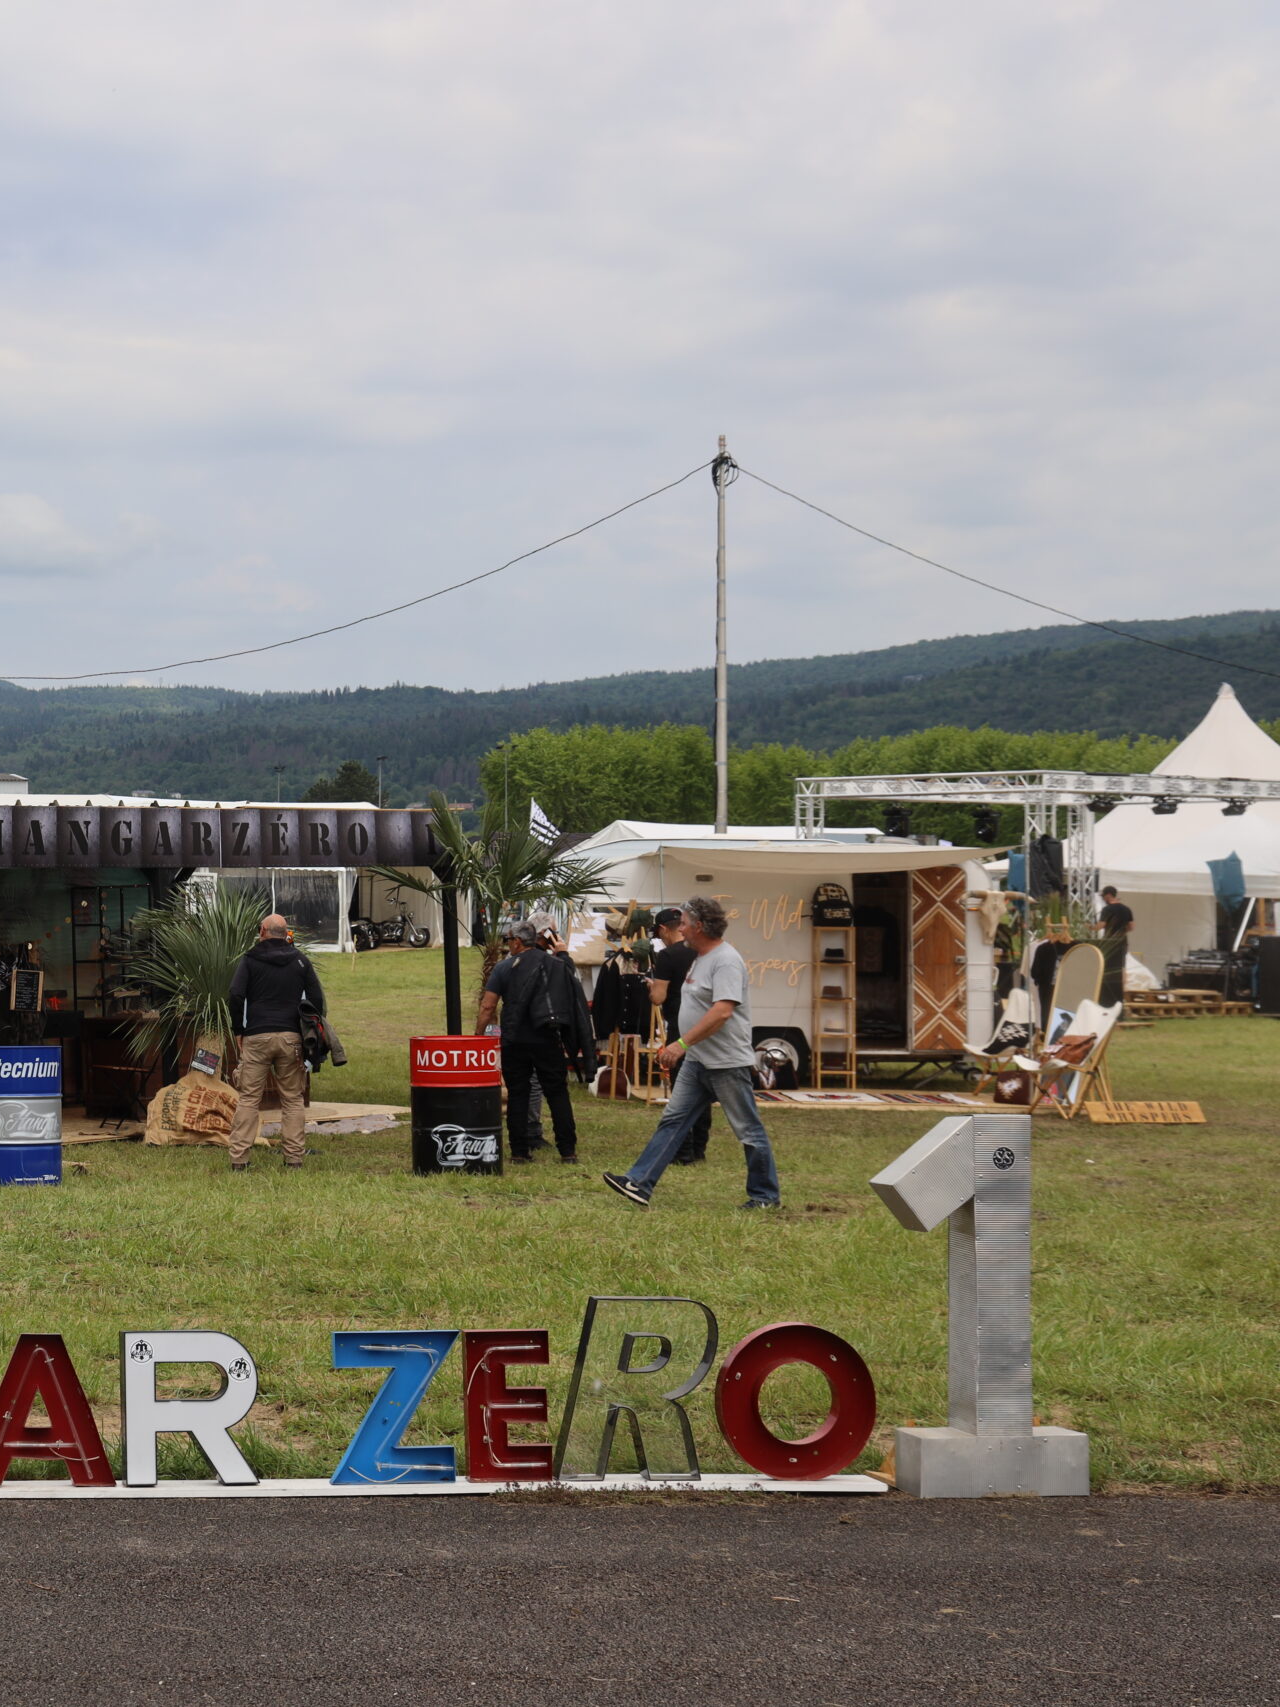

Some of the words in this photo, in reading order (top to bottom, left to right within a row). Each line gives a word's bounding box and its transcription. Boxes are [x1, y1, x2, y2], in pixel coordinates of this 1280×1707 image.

[231, 812, 369, 857] ZÉRO
[749, 894, 804, 940] Wild
[1104, 1102, 1133, 1112] THE
[1144, 1102, 1188, 1111] WILD
[1106, 1112, 1192, 1122] WHISPERS
[330, 1296, 876, 1486] ZERO
